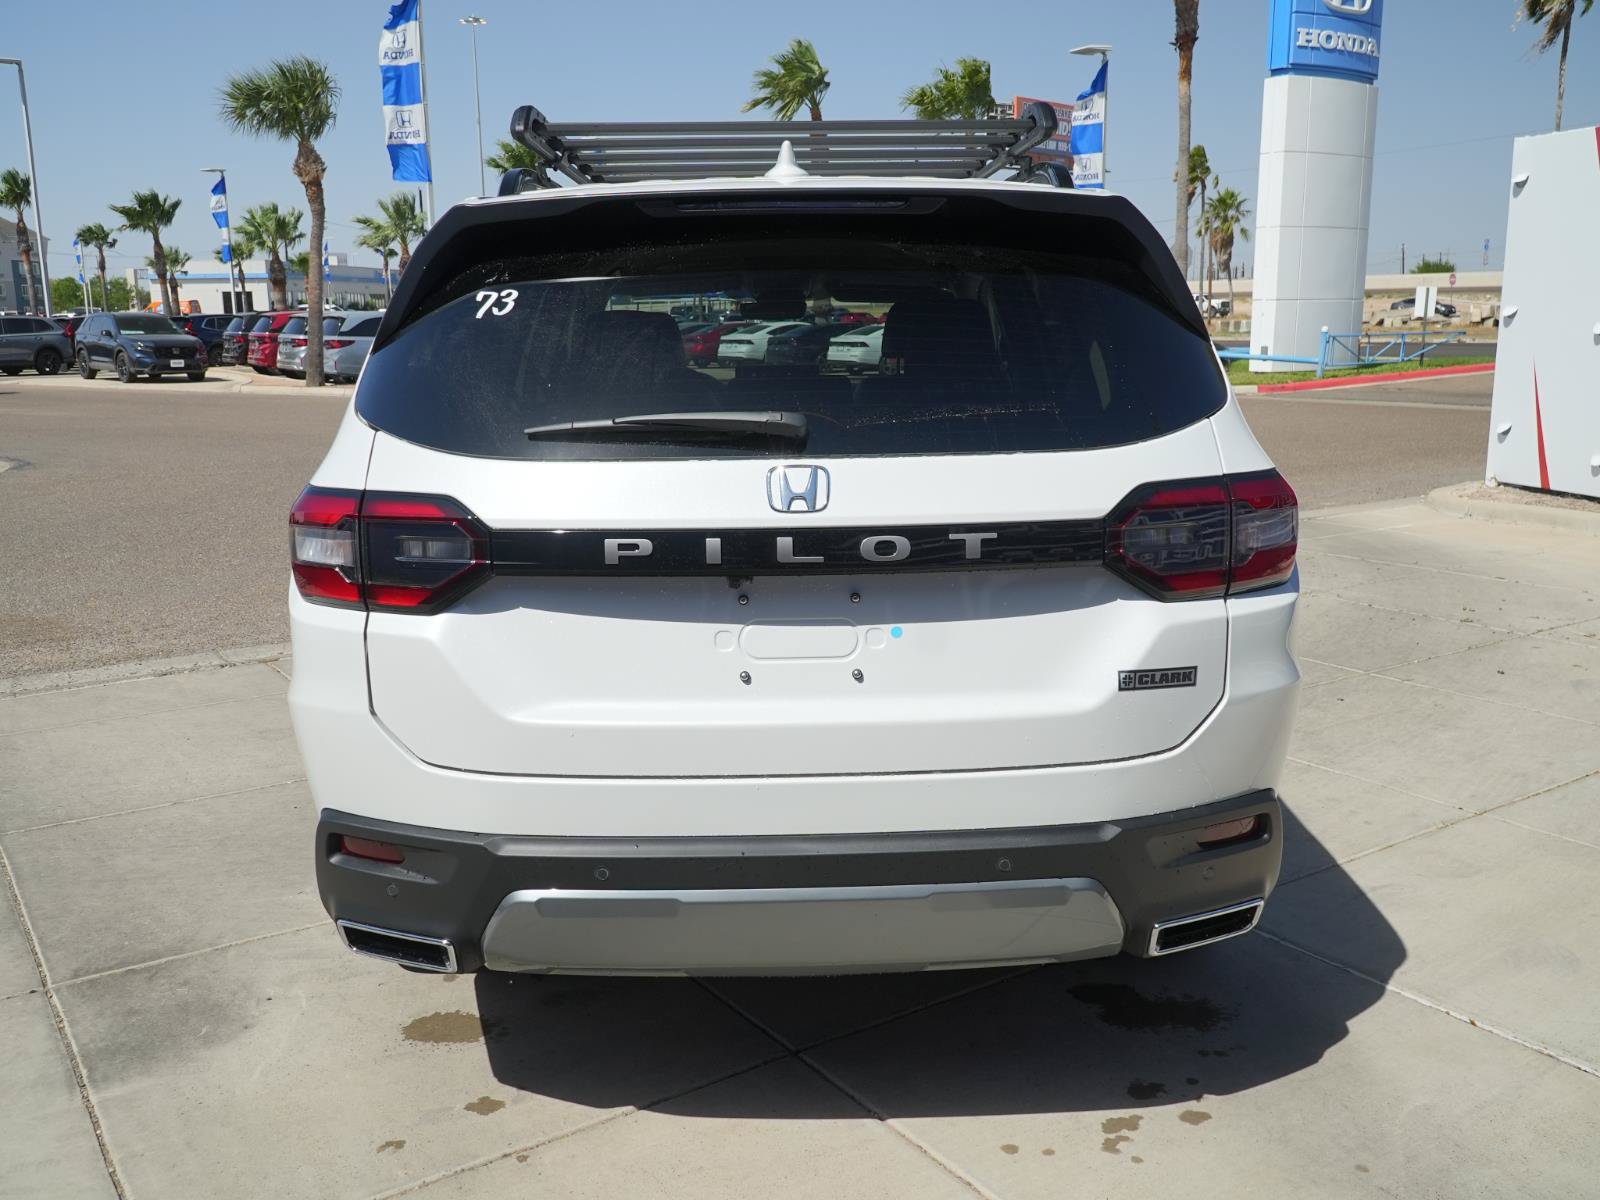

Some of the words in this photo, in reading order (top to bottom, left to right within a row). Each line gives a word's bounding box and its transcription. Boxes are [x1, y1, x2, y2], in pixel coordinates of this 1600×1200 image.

[1296, 27, 1380, 57] HONDA
[475, 288, 519, 319] 73
[604, 532, 998, 565] PILOT
[1137, 670, 1194, 686] CLARK
